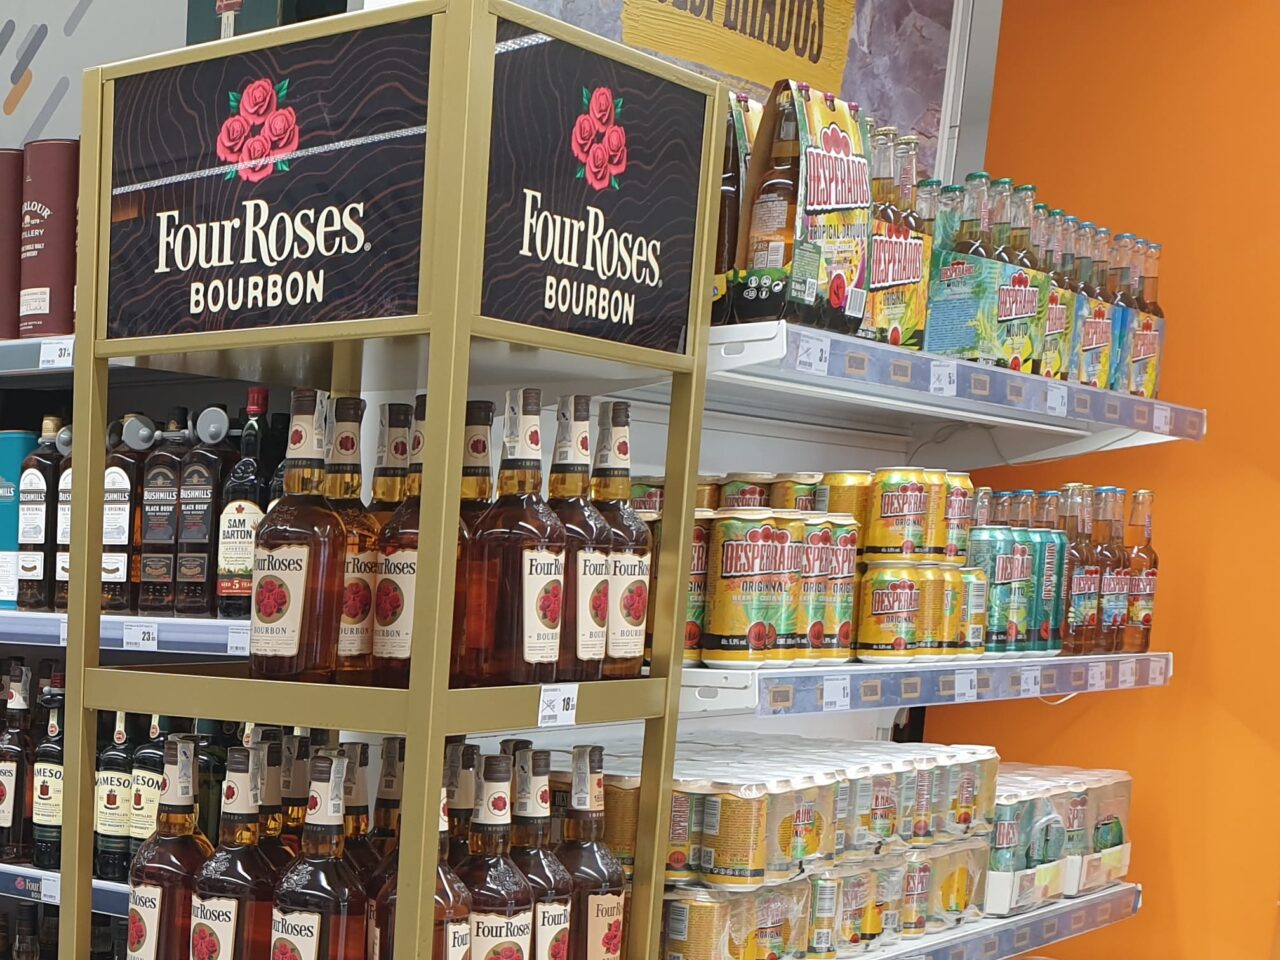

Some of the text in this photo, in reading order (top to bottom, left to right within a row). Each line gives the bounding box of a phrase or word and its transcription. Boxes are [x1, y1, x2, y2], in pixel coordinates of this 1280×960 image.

[807, 150, 870, 208] DESPERADOS
[871, 237, 923, 285] DESPERADOS
[189, 269, 325, 315] BOURBON
[544, 275, 635, 326] BOURBON
[998, 286, 1039, 320] DESPERADOS
[143, 490, 178, 500] BUSHMILLS
[180, 489, 212, 499] BUSHMILLS
[222, 528, 252, 540] BARTON
[227, 518, 246, 529] SAM
